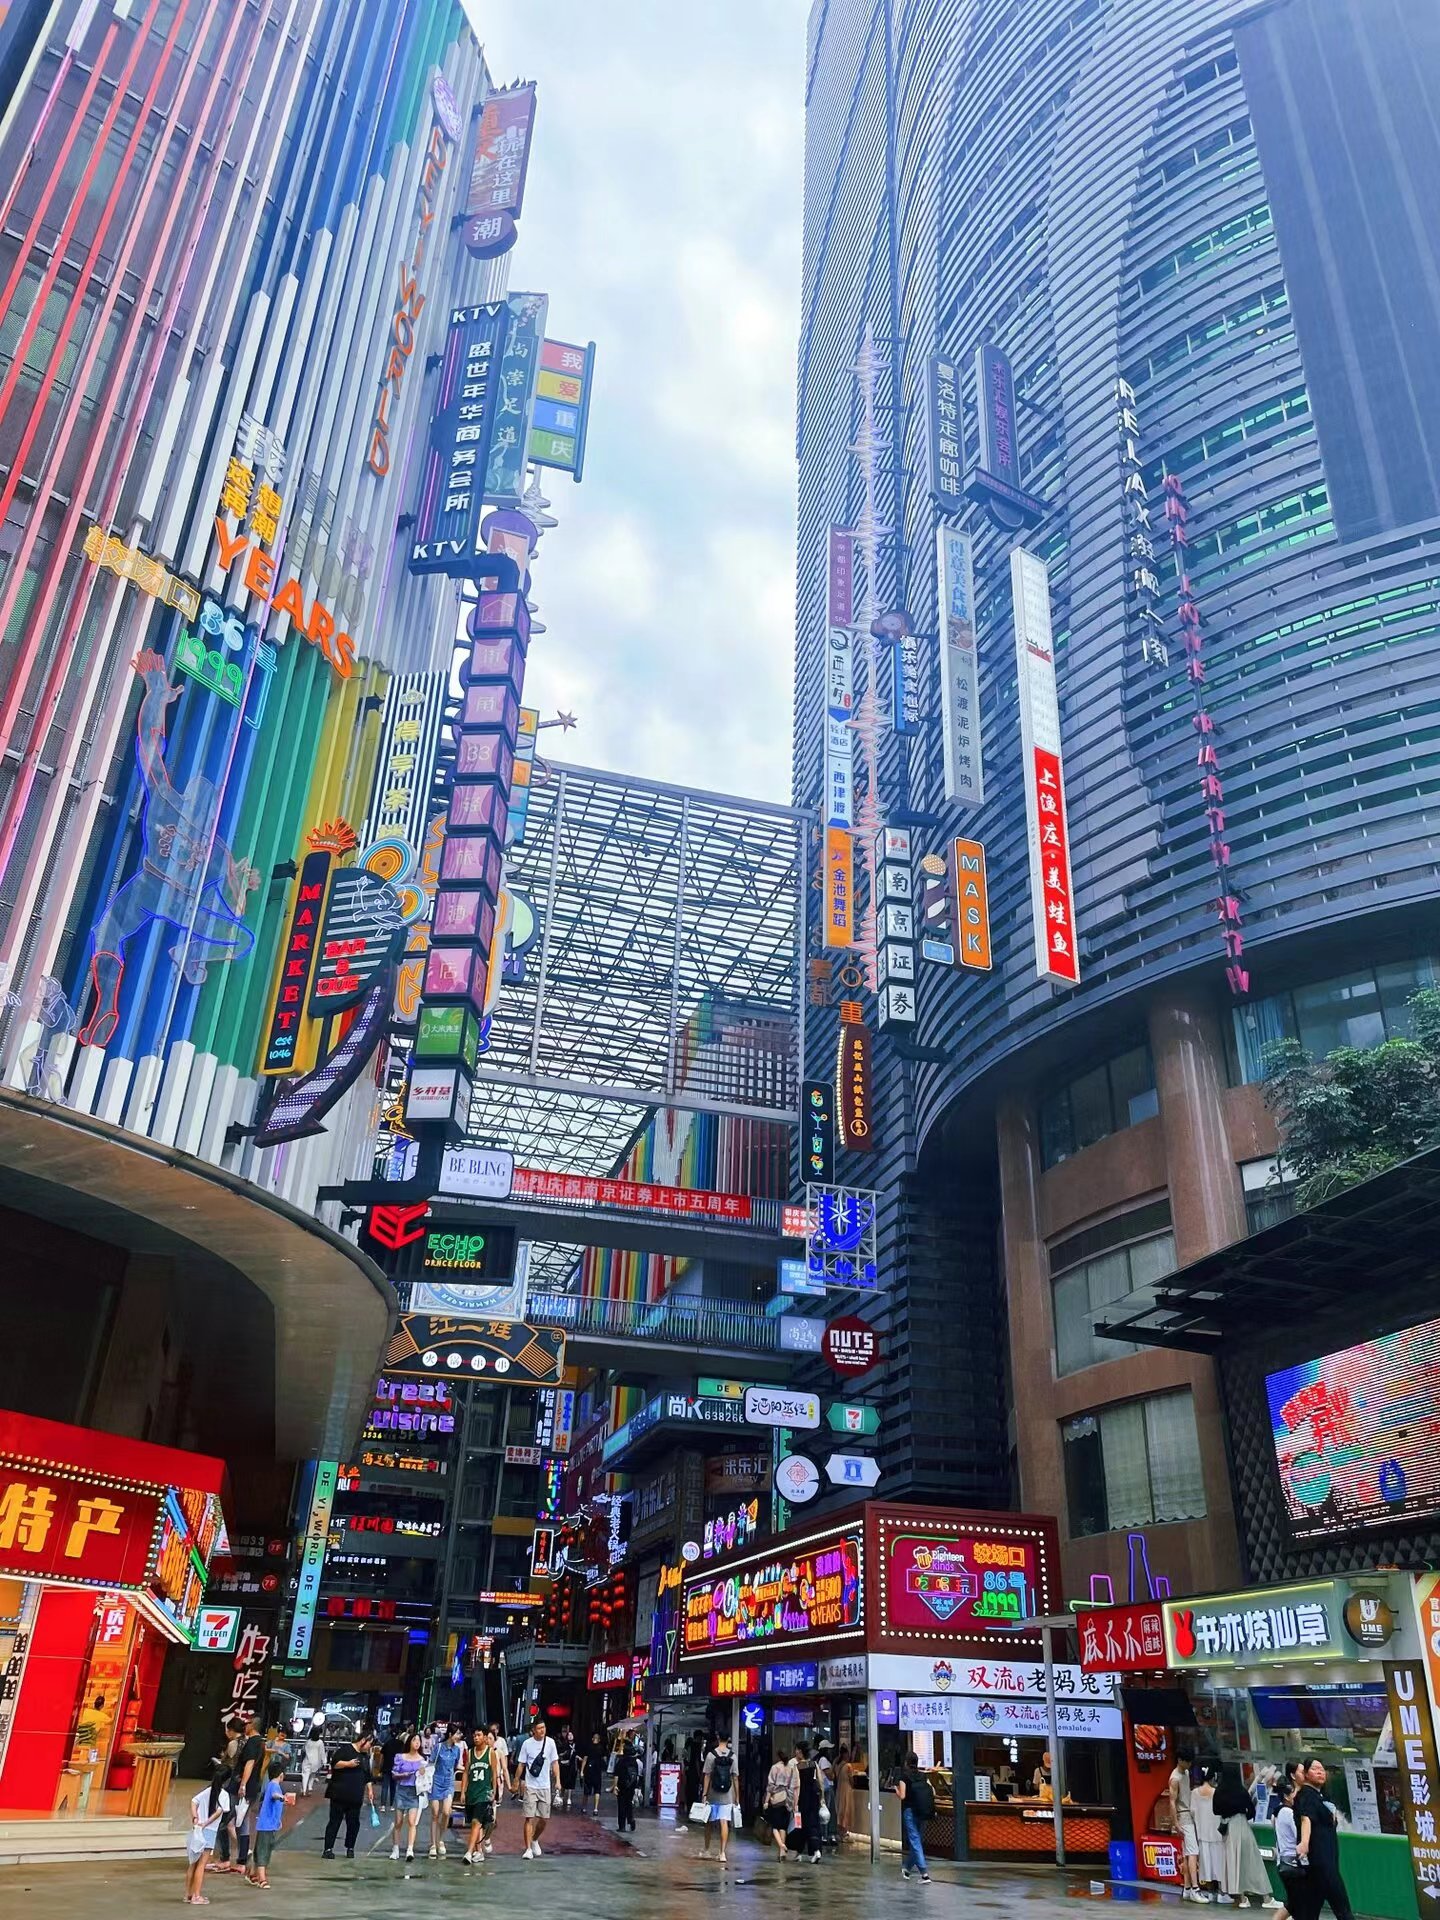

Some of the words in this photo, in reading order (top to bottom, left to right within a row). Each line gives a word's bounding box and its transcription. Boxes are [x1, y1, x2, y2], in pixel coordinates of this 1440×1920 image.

[472, 217, 502, 241] 潮
[452, 304, 500, 324] KTV
[550, 352, 582, 457] 我爱重庆
[445, 341, 492, 512] 盛世年华商务会所
[938, 361, 960, 496] 夏洛特走廊咖啡
[1116, 378, 1151, 531] RELAX
[413, 539, 467, 560] KTV
[214, 515, 356, 680] YEARS
[176, 628, 244, 698] 1999
[1193, 711, 1230, 869] PARTY
[832, 868, 847, 929] 金池舞蹈
[962, 855, 981, 953] MASK
[325, 938, 367, 959] BAR
[891, 871, 912, 1015] 南京证券
[277, 883, 323, 1030] MARKET
[316, 975, 360, 997] QUE
[839, 1000, 864, 1026] 重
[412, 1085, 452, 1097] 乡村基
[450, 1157, 466, 1174] BE
[469, 1159, 506, 1177] BLING
[514, 1170, 740, 1214] 热烈庆祝南京证券上市五周年
[427, 1233, 485, 1252] ECHO
[432, 1248, 476, 1262] CUBE
[453, 1261, 482, 1270] FLOOR
[808, 1257, 877, 1279] UME
[829, 1329, 874, 1349] NUTS
[374, 1379, 449, 1403] treet
[716, 1384, 730, 1393] DE
[725, 1457, 768, 1476] 米乐汇
[321, 1471, 331, 1487] DE
[0, 1482, 125, 1558] 特产
[307, 1519, 324, 1566] WORLD
[931, 1550, 965, 1564] Eighteen
[973, 1542, 1026, 1568] 较场口
[932, 1561, 955, 1572] kinds
[264, 1580, 276, 1588] 7F
[304, 1575, 314, 1591] DE
[300, 1602, 310, 1615] YI
[982, 1590, 1019, 1611] 1999
[1143, 1619, 1160, 1634] 麻辣
[1197, 1604, 1330, 1654] 书亦烧仙草
[1361, 1623, 1383, 1633] UME
[293, 1625, 307, 1658] WOR
[1082, 1617, 1142, 1666] 麻爪爪
[1144, 1635, 1161, 1652] 卤味
[1354, 1768, 1372, 1793] 聘
